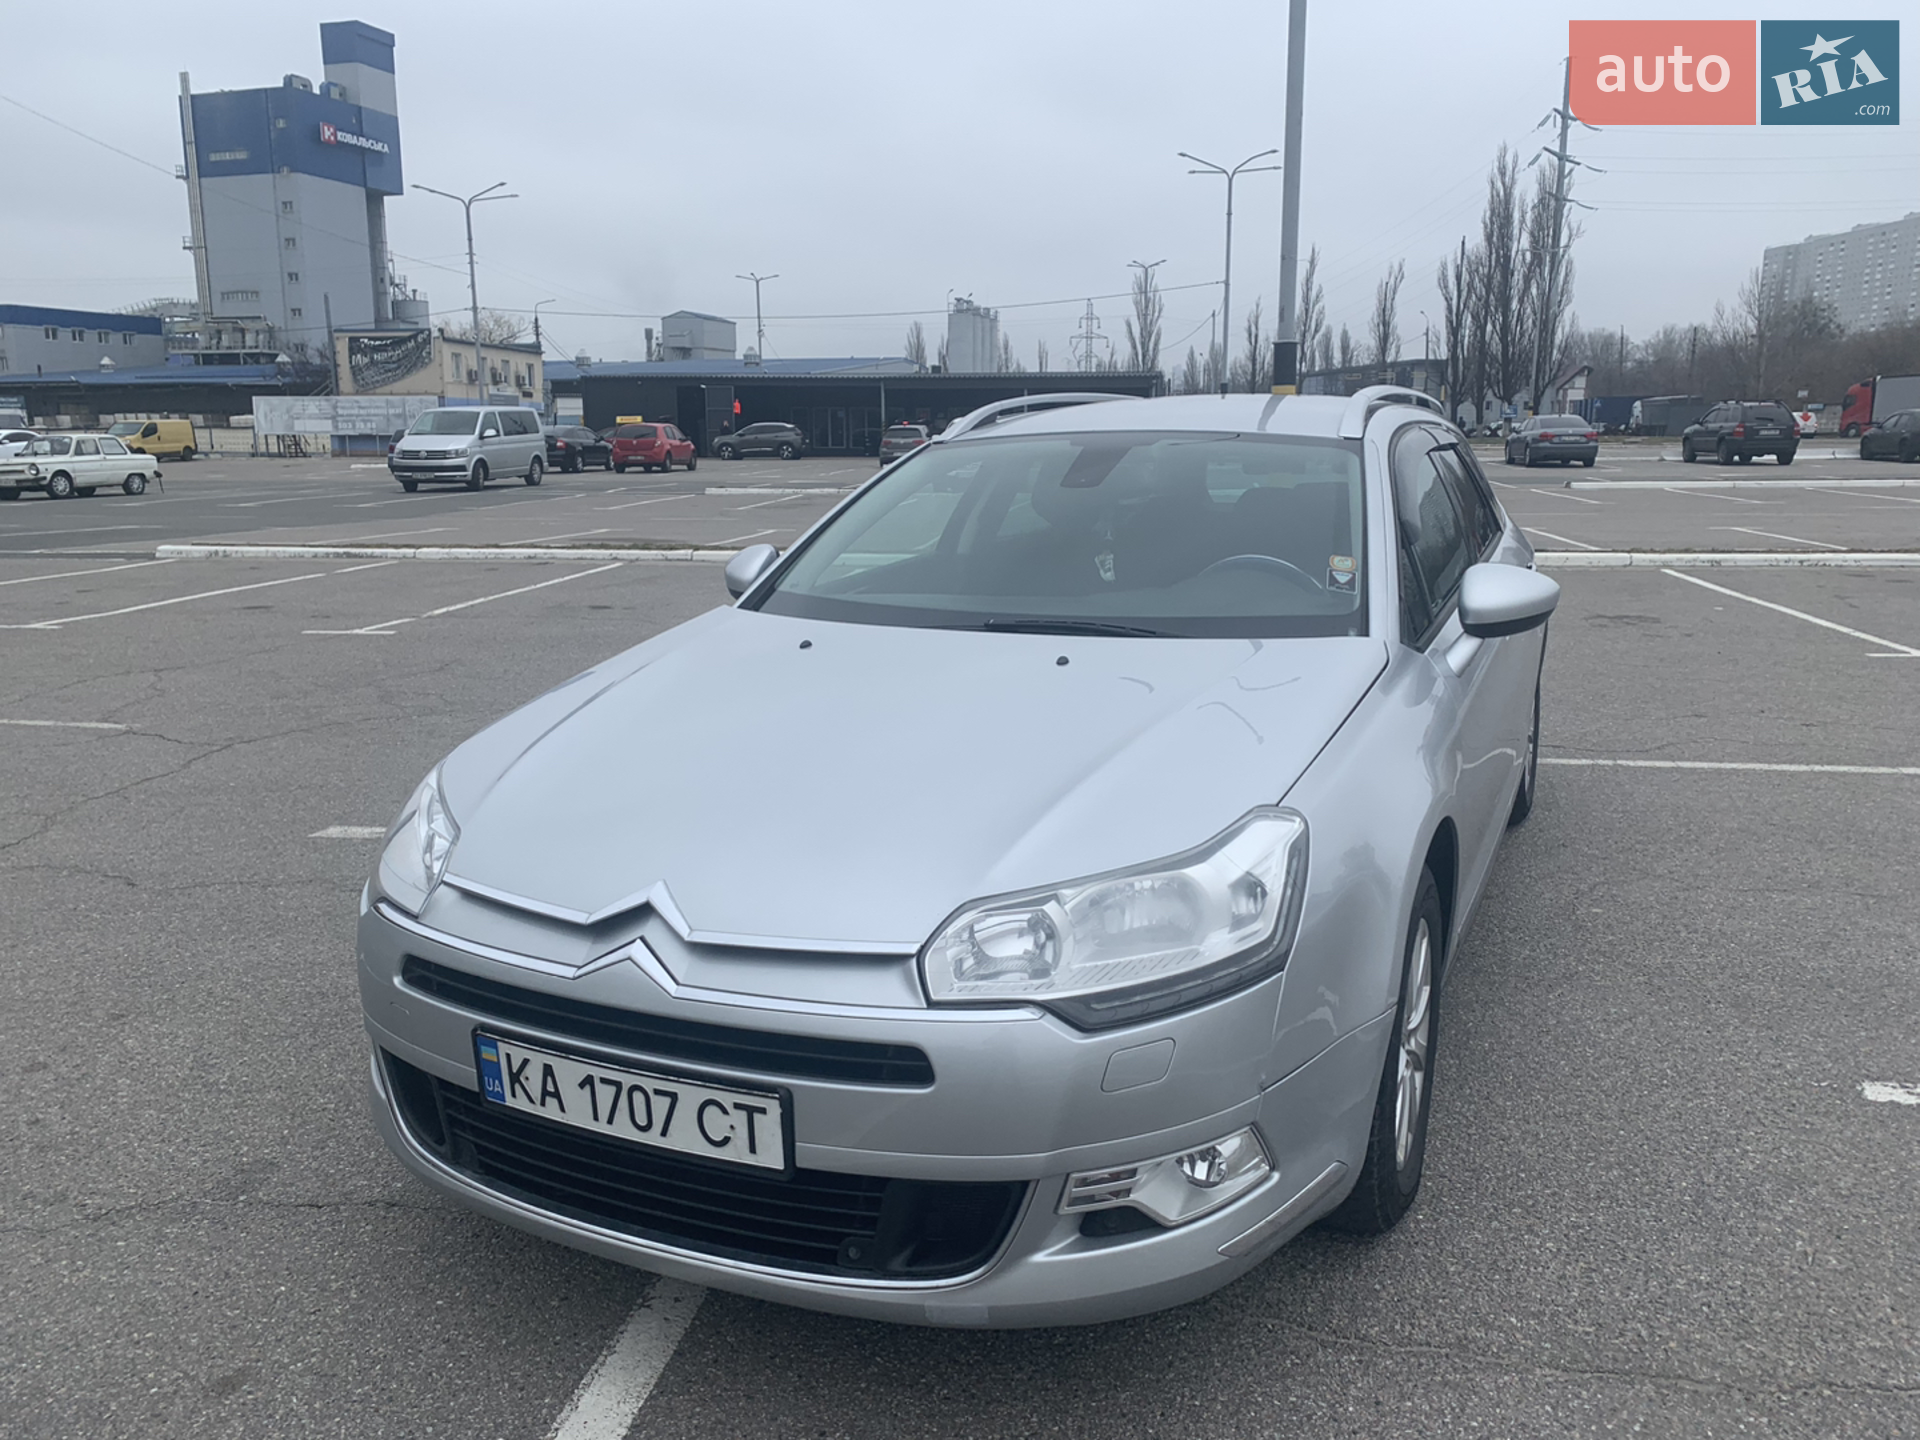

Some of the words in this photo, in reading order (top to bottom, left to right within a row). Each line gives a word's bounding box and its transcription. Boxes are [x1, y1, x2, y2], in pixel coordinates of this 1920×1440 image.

[336, 130, 390, 154] КОВАЛЬСЬКА
[485, 1076, 503, 1094] UA
[505, 1052, 567, 1114] KA
[578, 1073, 679, 1138] 1707
[697, 1098, 768, 1155] CT
